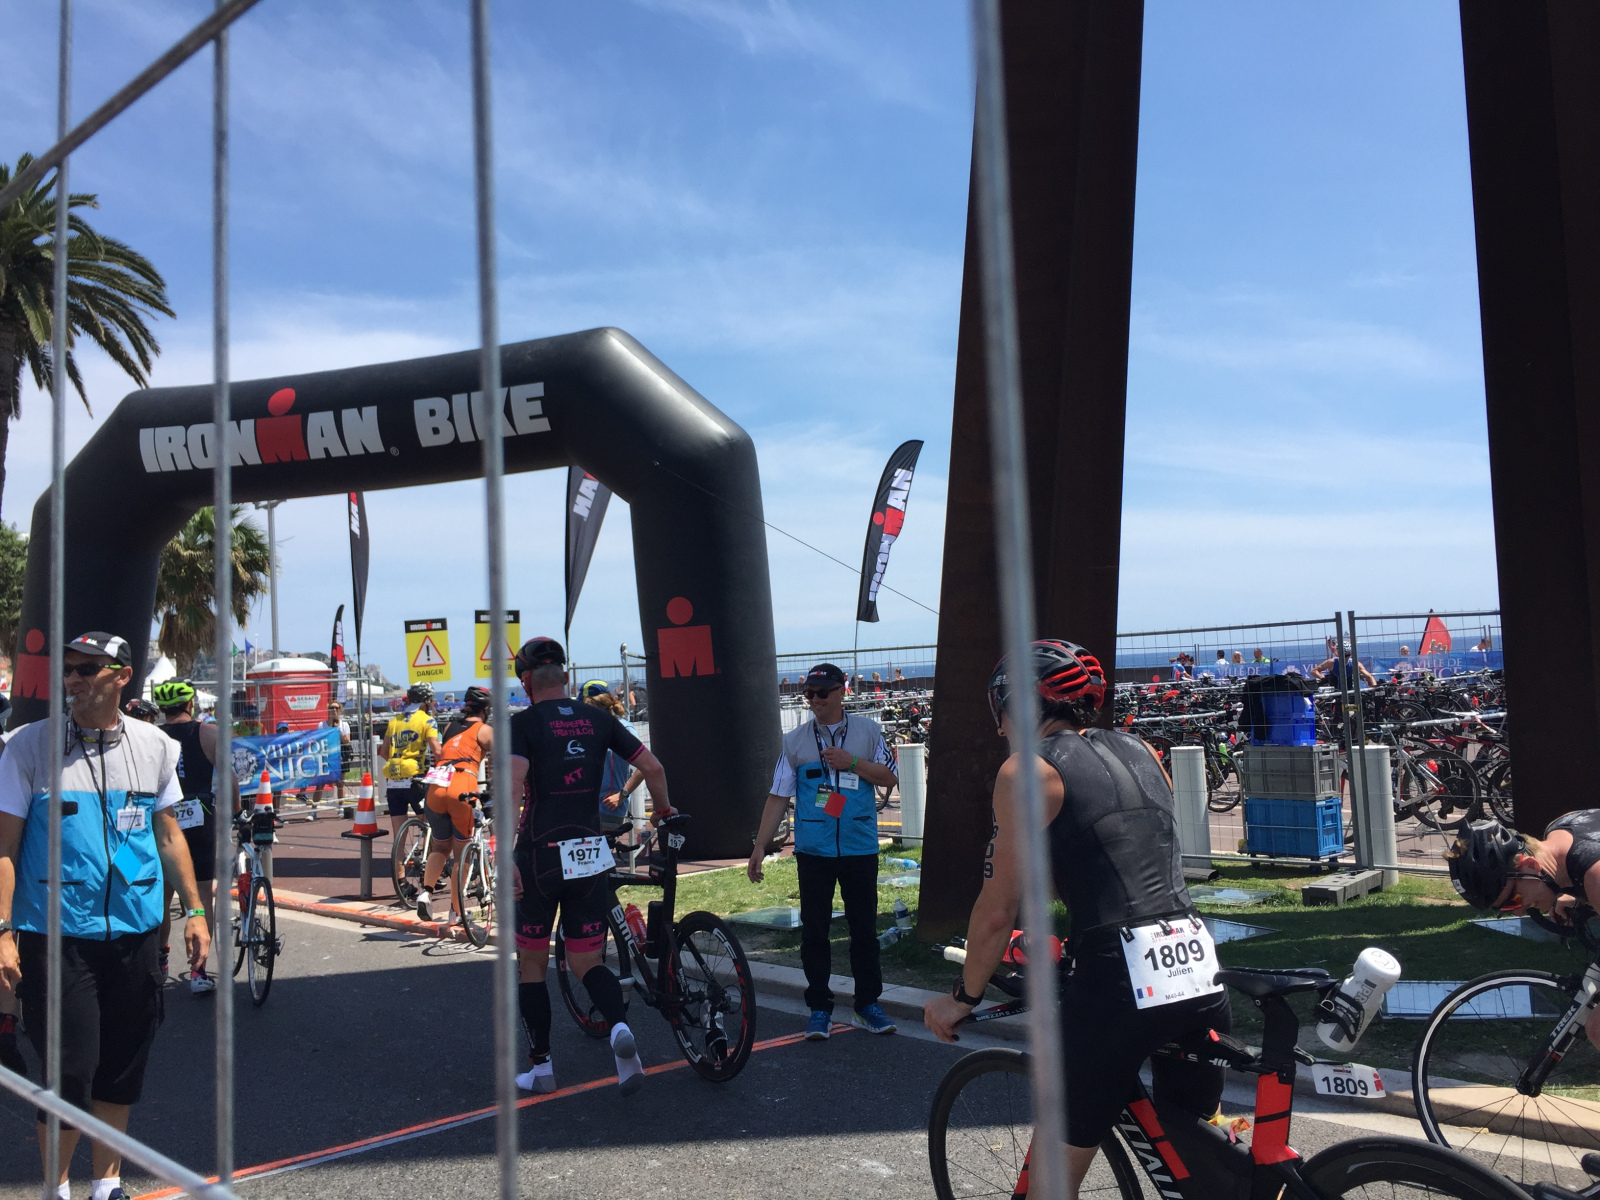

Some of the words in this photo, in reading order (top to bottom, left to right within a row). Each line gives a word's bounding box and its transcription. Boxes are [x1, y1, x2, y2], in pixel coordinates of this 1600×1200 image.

[139, 388, 385, 472] IRONMAN
[413, 382, 551, 447] BIKE
[1246, 667, 1261, 677] DE
[1416, 658, 1446, 668] VILLE
[1447, 658, 1462, 667] DE
[416, 669, 444, 677] DANGER
[260, 741, 304, 758] VILLE
[307, 739, 329, 754] DE
[264, 753, 330, 780] NICE
[564, 767, 582, 785] KT
[568, 848, 601, 862] 1977
[522, 924, 544, 934] KT
[582, 922, 602, 934] KT
[611, 904, 640, 957] BMC
[1144, 939, 1205, 971] 1809
[1167, 966, 1194, 978] Julien
[1549, 1004, 1577, 1038] TREK
[1322, 1076, 1368, 1096] 1809
